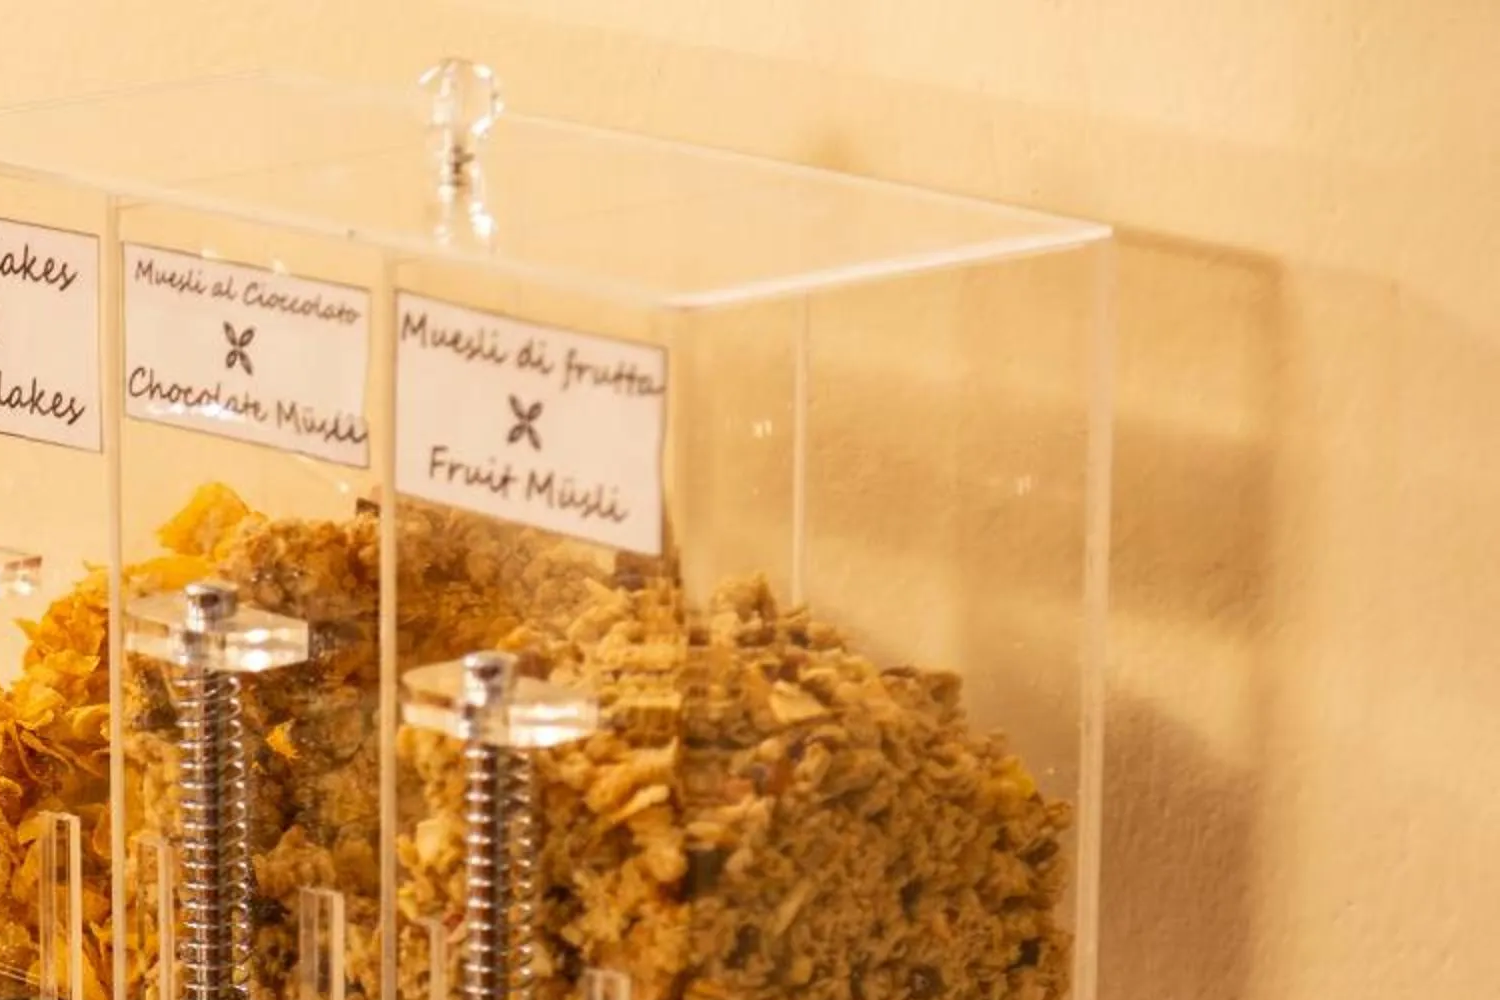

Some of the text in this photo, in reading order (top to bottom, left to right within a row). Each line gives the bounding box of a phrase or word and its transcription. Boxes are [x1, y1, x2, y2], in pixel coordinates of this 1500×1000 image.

[134, 260, 206, 295] Muesli
[211, 276, 237, 301] al
[401, 311, 667, 396] Muesli di frutta
[128, 366, 268, 422] Chocolate
[429, 445, 629, 523] Fruit Müsli
